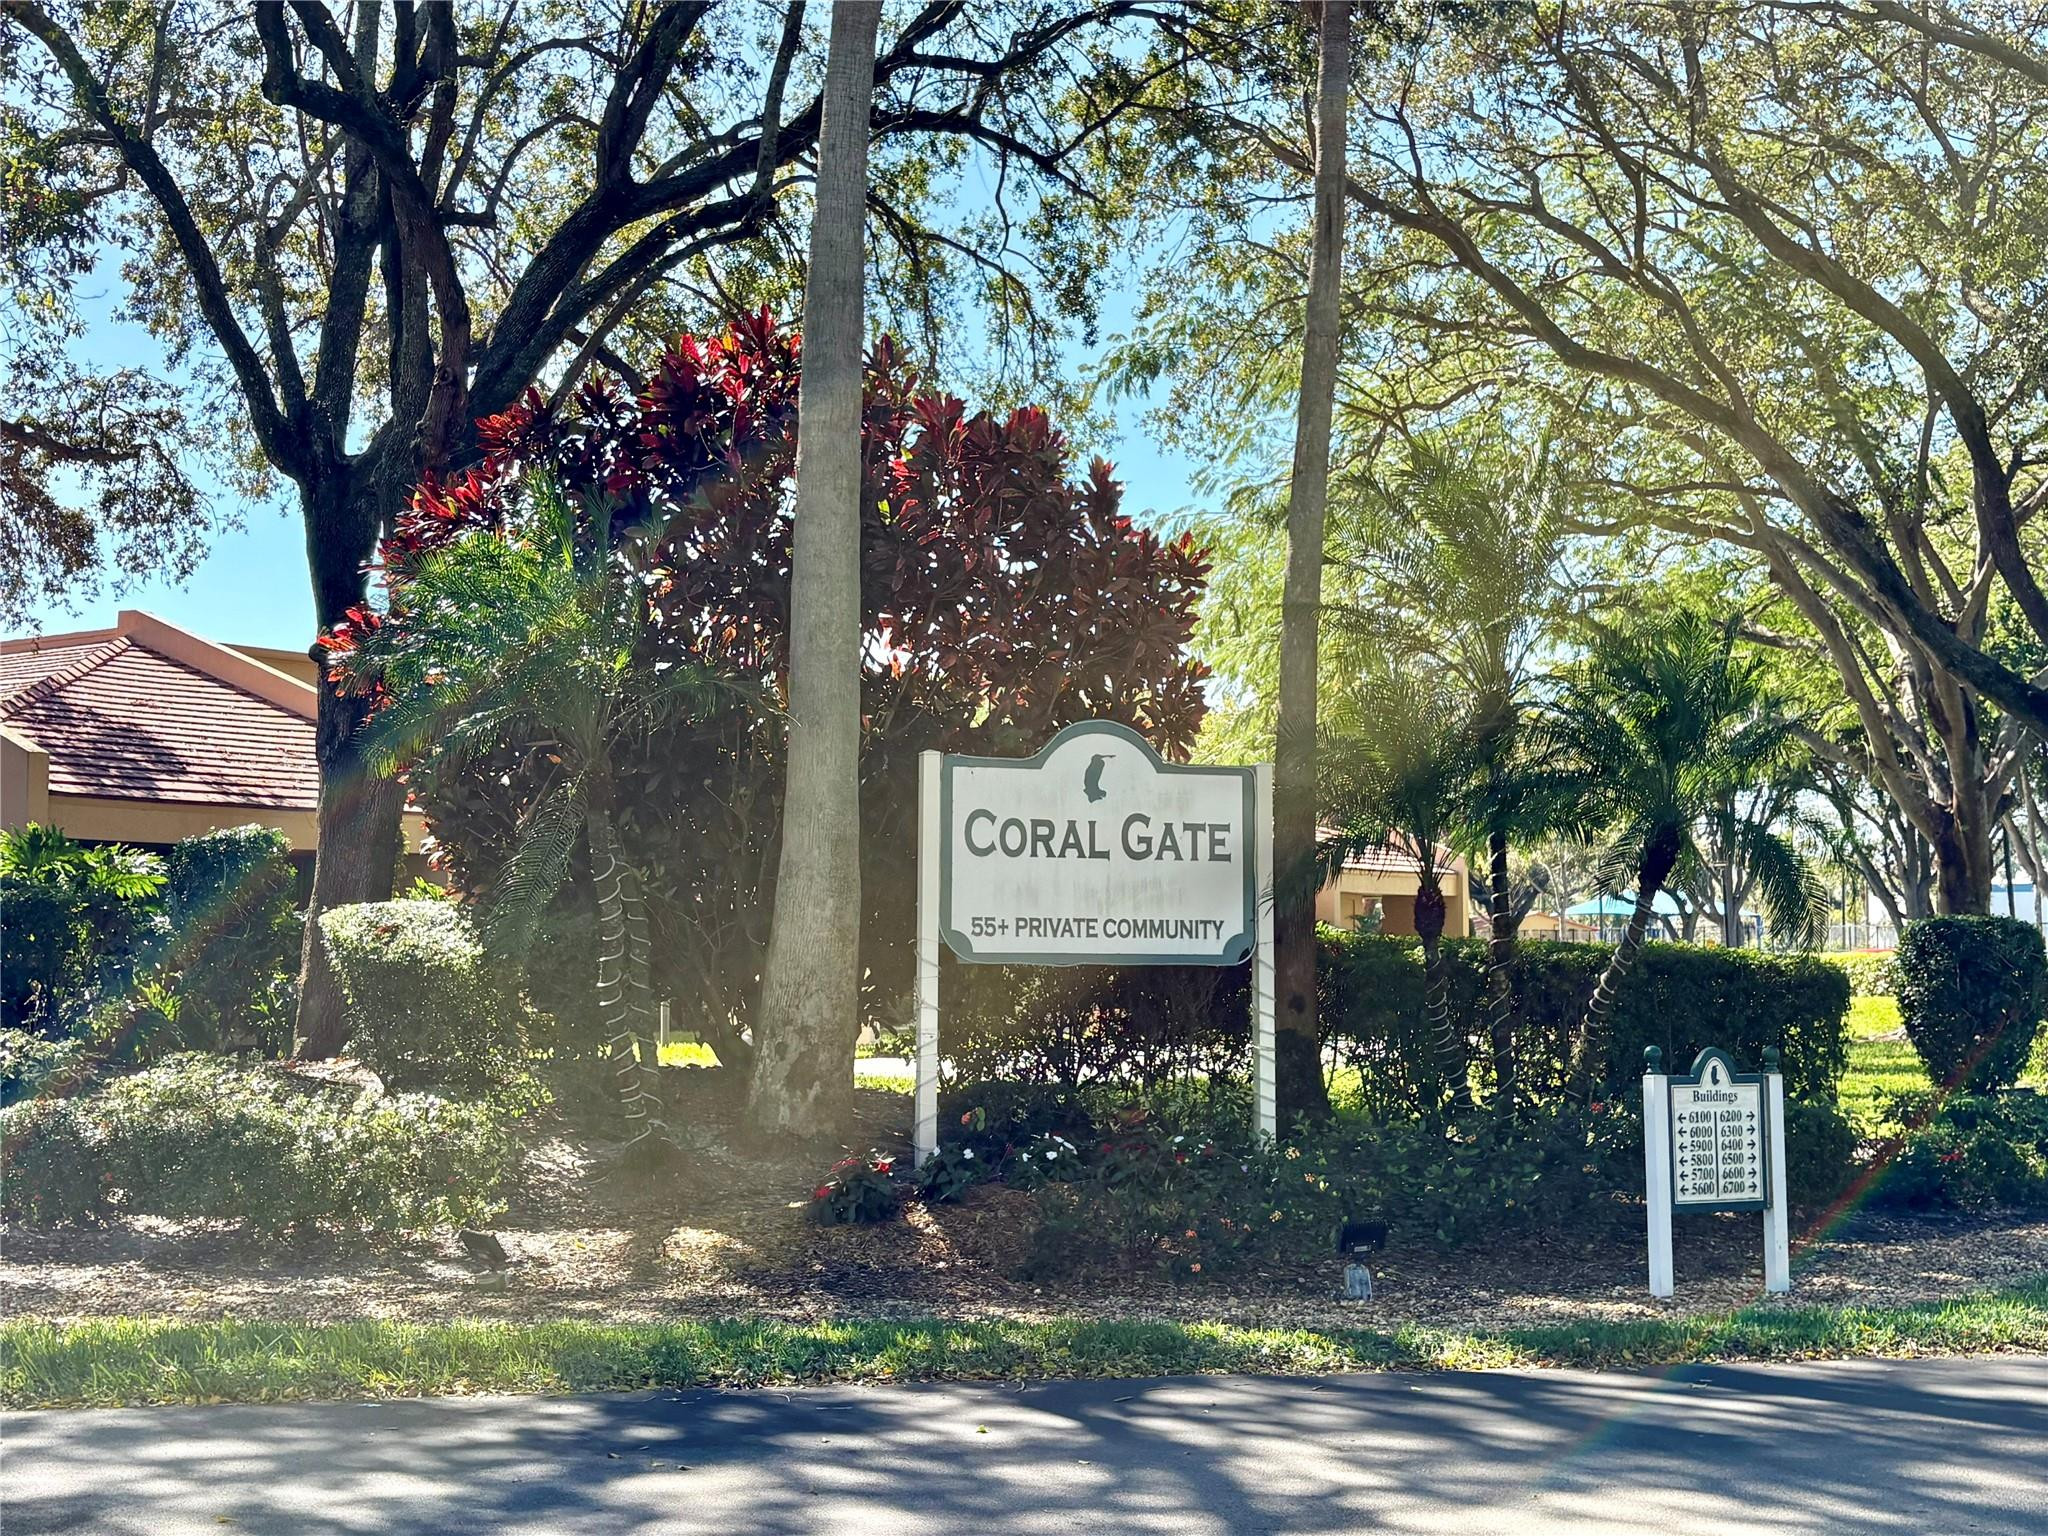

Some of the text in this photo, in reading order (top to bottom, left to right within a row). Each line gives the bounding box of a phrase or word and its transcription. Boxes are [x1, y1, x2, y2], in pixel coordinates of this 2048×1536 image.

[964, 808, 1232, 863] CORAL GATE
[970, 916, 1225, 940] 55+ PRIVATE COMMUNITY
[1693, 1090, 1738, 1104] Buildings
[1688, 1111, 1712, 1123] 6100
[1720, 1110, 1742, 1122] 6200
[1690, 1126, 1713, 1138] 6000
[1721, 1125, 1743, 1137] 6300
[1690, 1139, 1713, 1152] 5900
[1721, 1139, 1743, 1150] 6400
[1690, 1154, 1713, 1166] 5800
[1722, 1153, 1744, 1165] 6500
[1691, 1168, 1714, 1180] 5700
[1722, 1167, 1745, 1179] 6600
[1691, 1182, 1715, 1195] 5600
[1723, 1181, 1745, 1193] 6700
